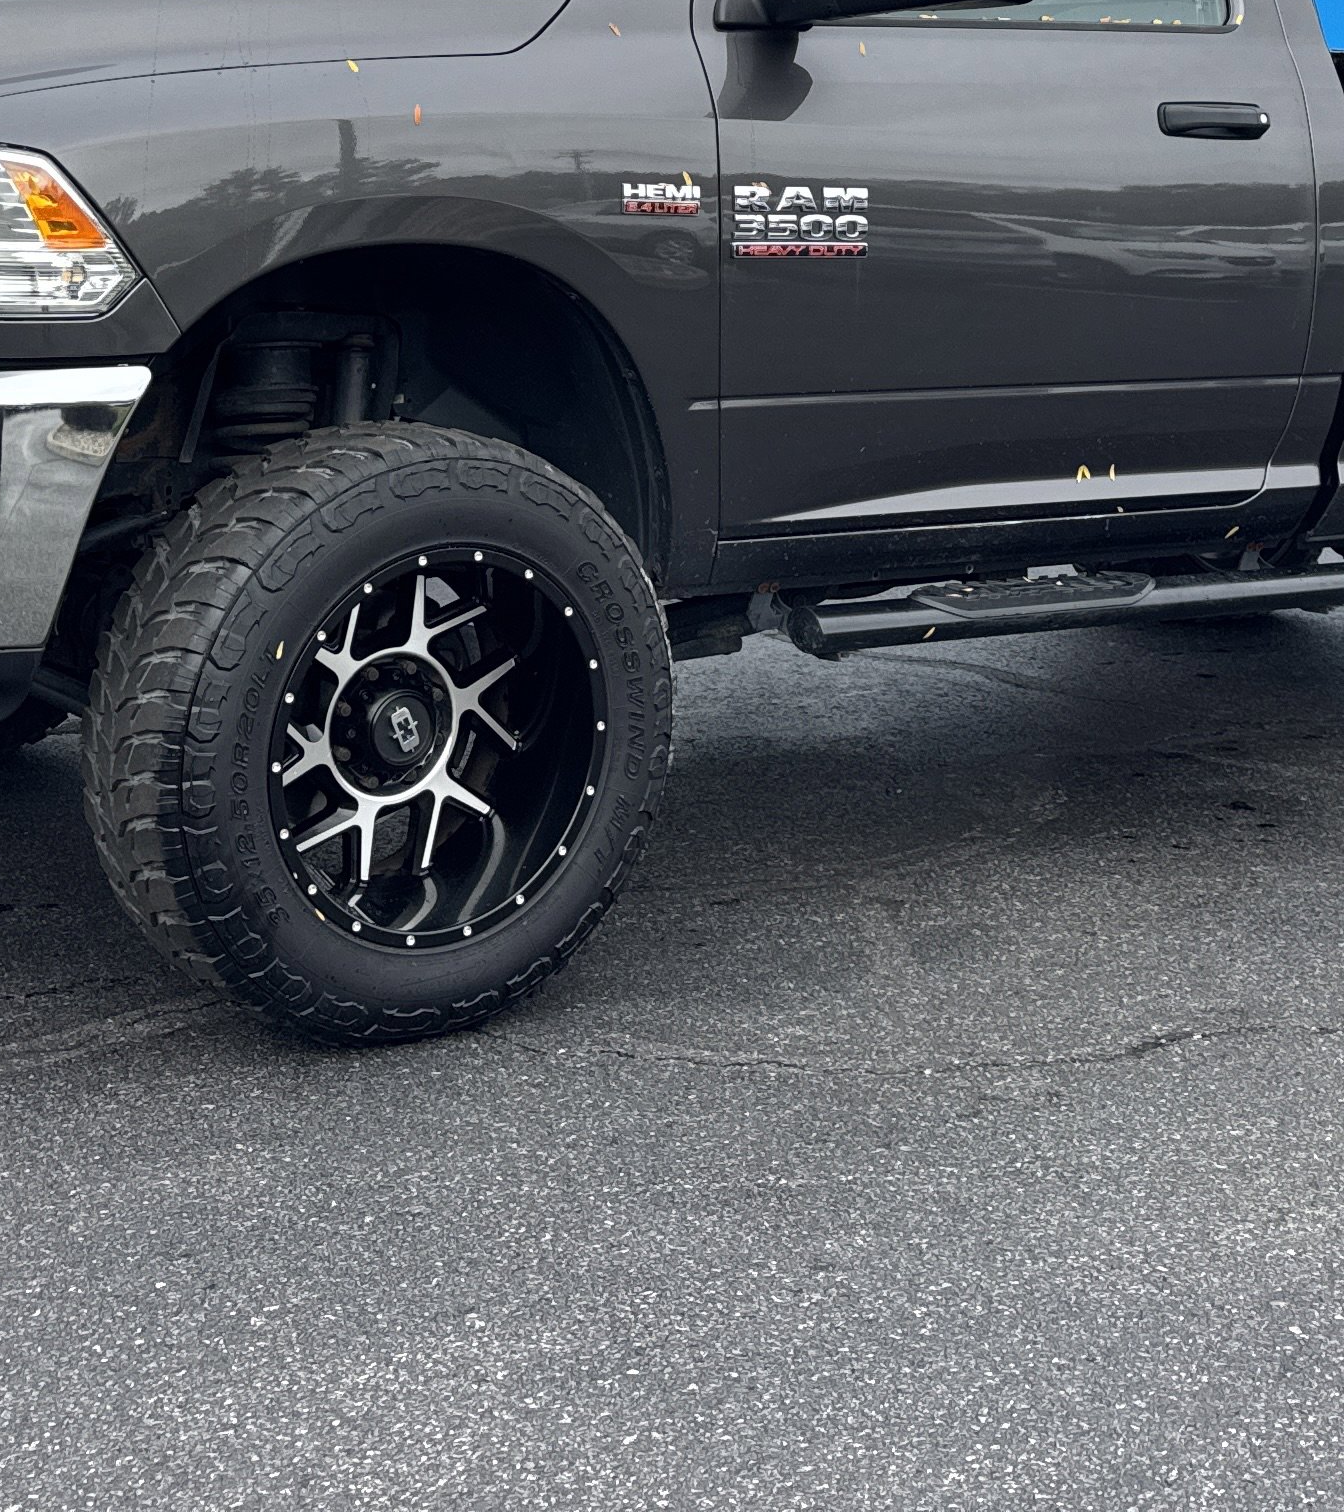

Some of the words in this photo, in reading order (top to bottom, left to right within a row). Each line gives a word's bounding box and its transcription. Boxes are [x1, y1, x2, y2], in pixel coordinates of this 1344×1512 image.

[622, 183, 701, 199] HEMI
[733, 185, 869, 212] RAM
[732, 214, 869, 240] 3500
[738, 245, 806, 256] HEAVY
[808, 245, 864, 256] DUTY
[576, 560, 647, 780] CROSSWIND
